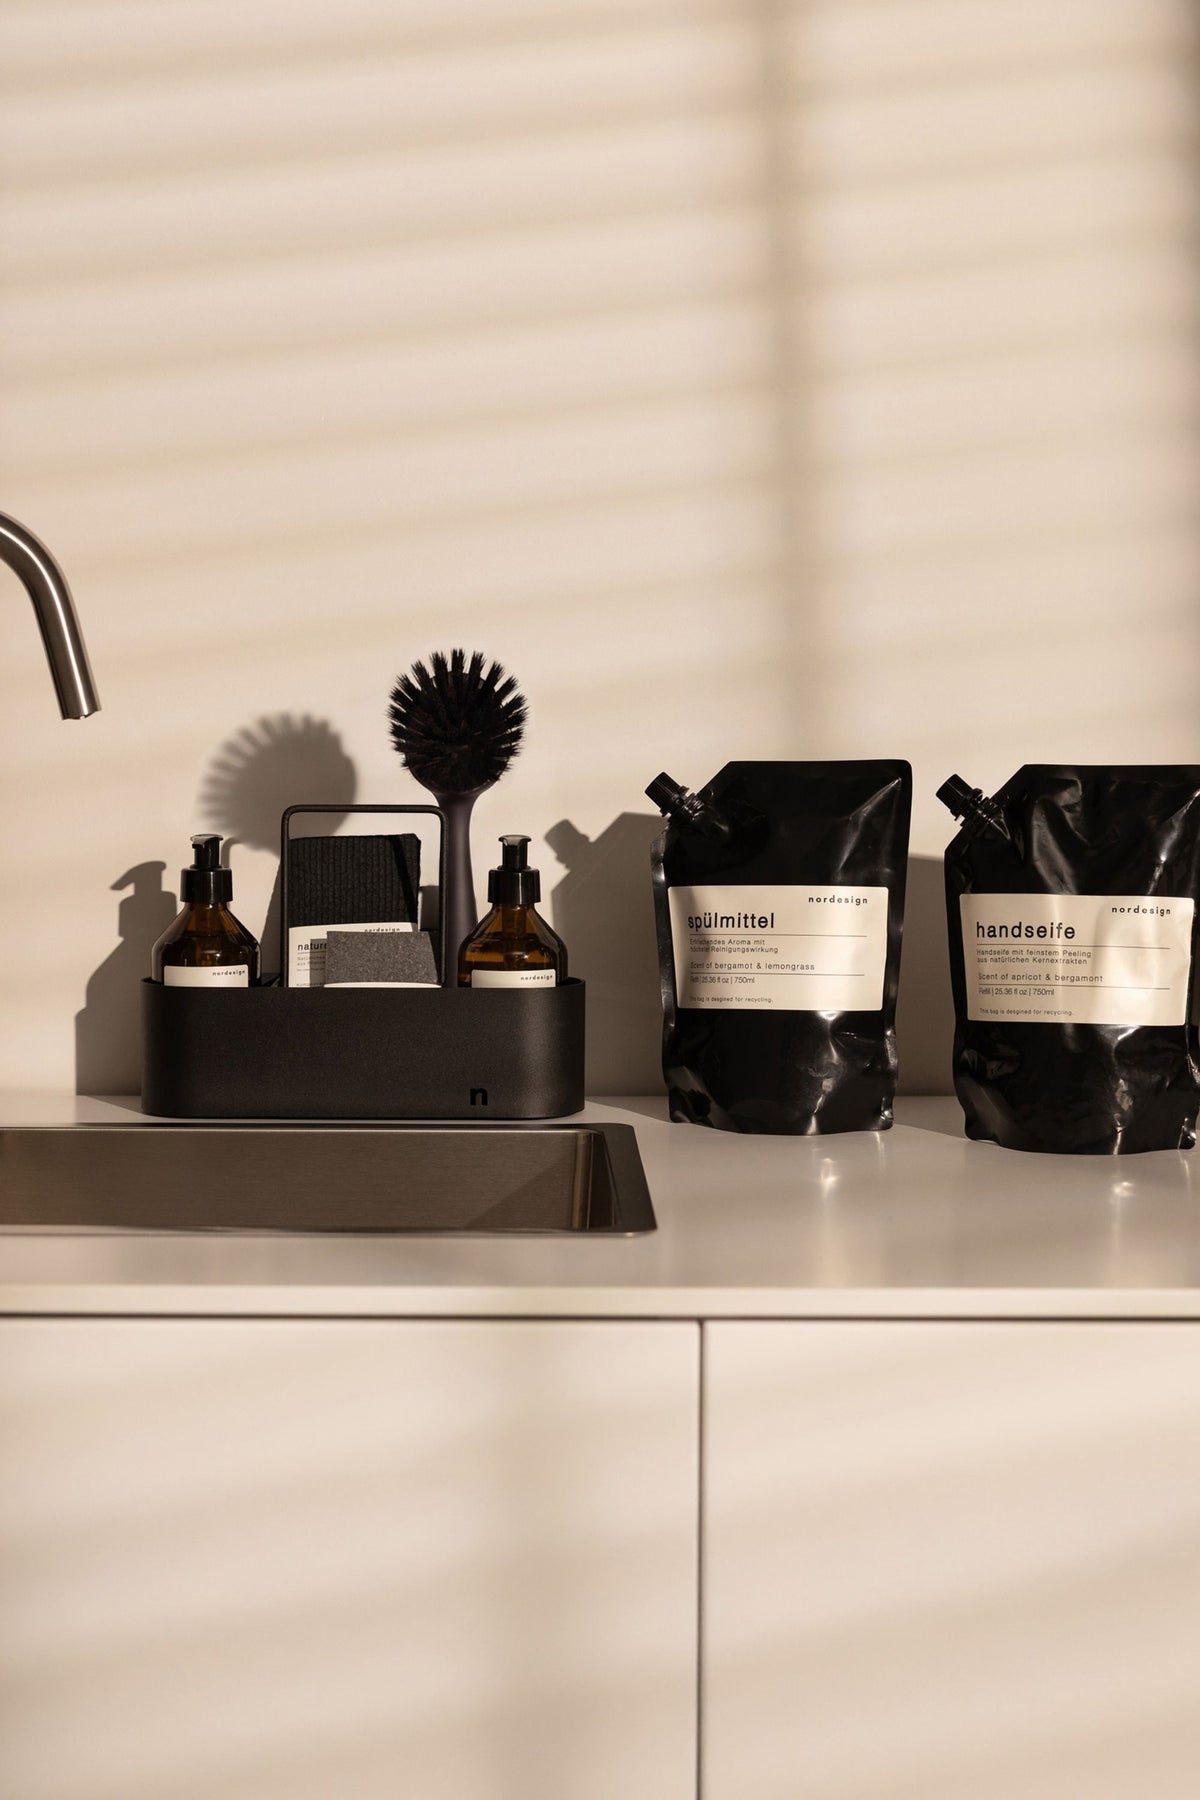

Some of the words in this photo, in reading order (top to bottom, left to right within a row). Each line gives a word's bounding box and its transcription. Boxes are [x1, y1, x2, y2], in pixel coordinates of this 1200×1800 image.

[808, 895, 868, 906] nordesign
[1112, 905, 1171, 916] nordesign
[688, 912, 774, 932] spülmittel
[976, 922, 1076, 938] handseife
[298, 942, 327, 950] natur
[715, 962, 752, 970] bergamot
[765, 962, 815, 971] lemongrass
[1032, 957, 1088, 965] Kernextrakten
[1012, 974, 1042, 982] apricot
[1055, 974, 1103, 983] bergamont
[470, 1088, 488, 1106] n
